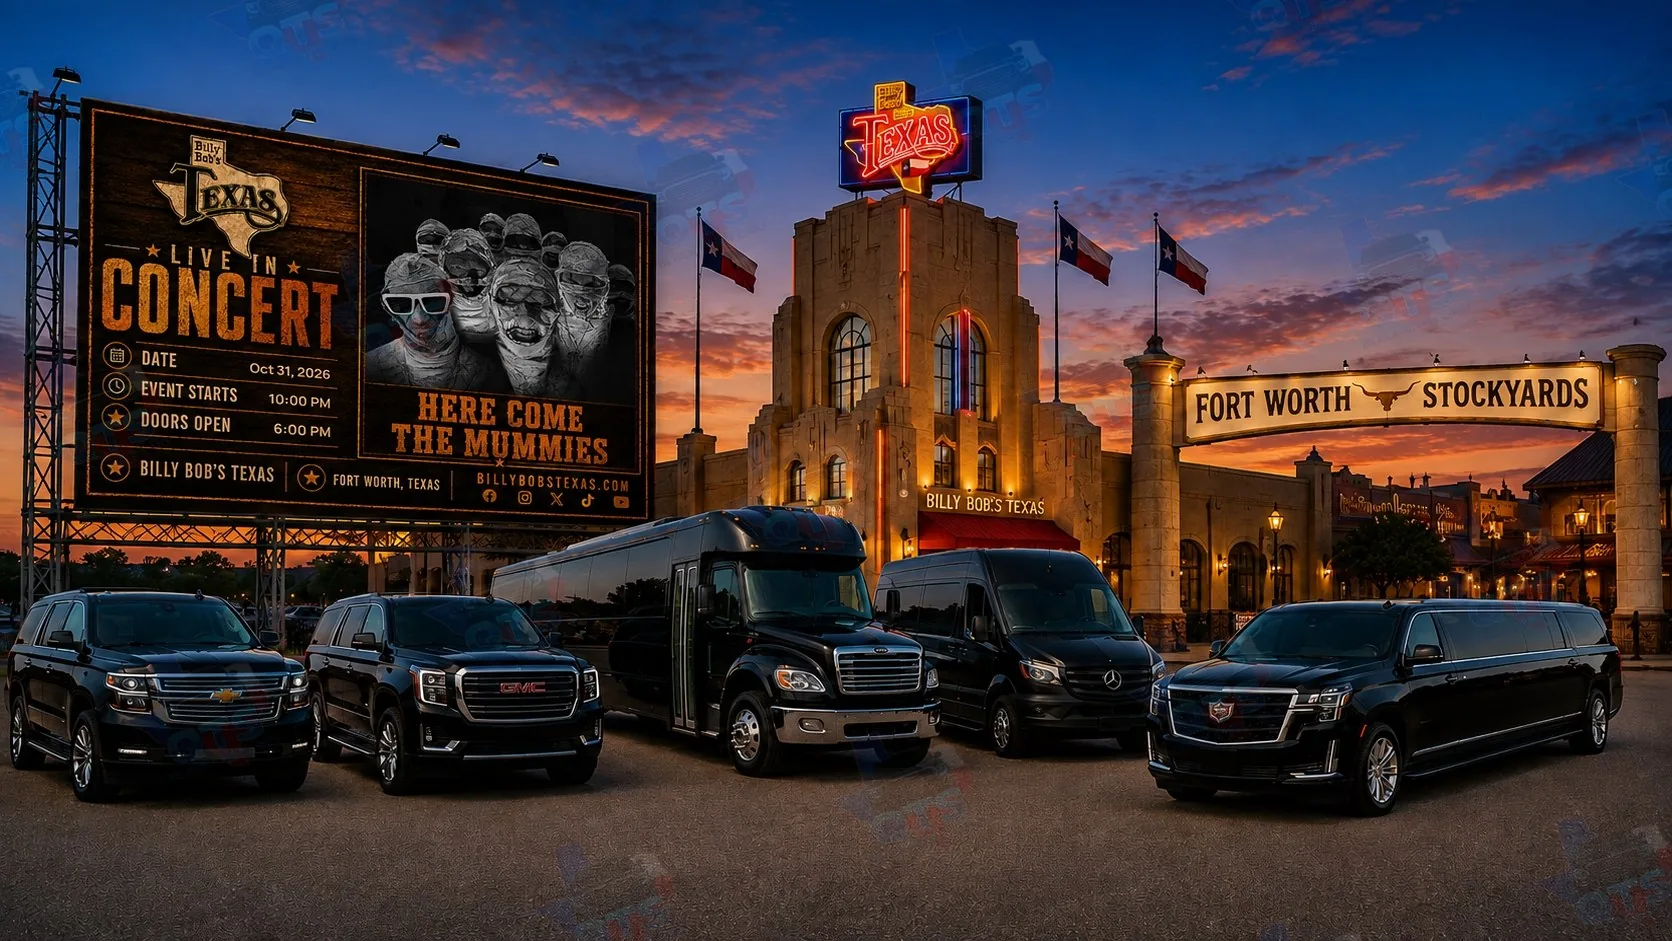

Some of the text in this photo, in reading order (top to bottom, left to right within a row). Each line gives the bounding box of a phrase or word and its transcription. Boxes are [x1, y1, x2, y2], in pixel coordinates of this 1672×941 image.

[194, 140, 221, 154] Billy
[194, 152, 222, 165] Bob's
[171, 244, 277, 276] LIVE IN
[102, 258, 339, 350] CONCERT
[142, 350, 177, 368] DATE
[250, 362, 331, 380] Oct 31, 2026
[141, 380, 238, 403] EVENT STARTS
[268, 393, 331, 409] 10:00 PM
[1196, 378, 1589, 424] FORT WORTH STOCKYARDS
[141, 411, 231, 433] DOORS OPEN
[418, 391, 583, 432] HERE COME
[273, 423, 331, 438] 6:00 PM
[391, 423, 608, 465] THE MUMMIES
[140, 460, 275, 482] BILLY BOB'S TEXAS
[333, 474, 441, 491] FORT WORTH, TEXAS
[477, 472, 629, 492] BILLYBOBSTEXAS.COM
[926, 493, 961, 510] BILLY
[1005, 498, 1045, 515] TEXAS
[500, 682, 546, 693] GMC
